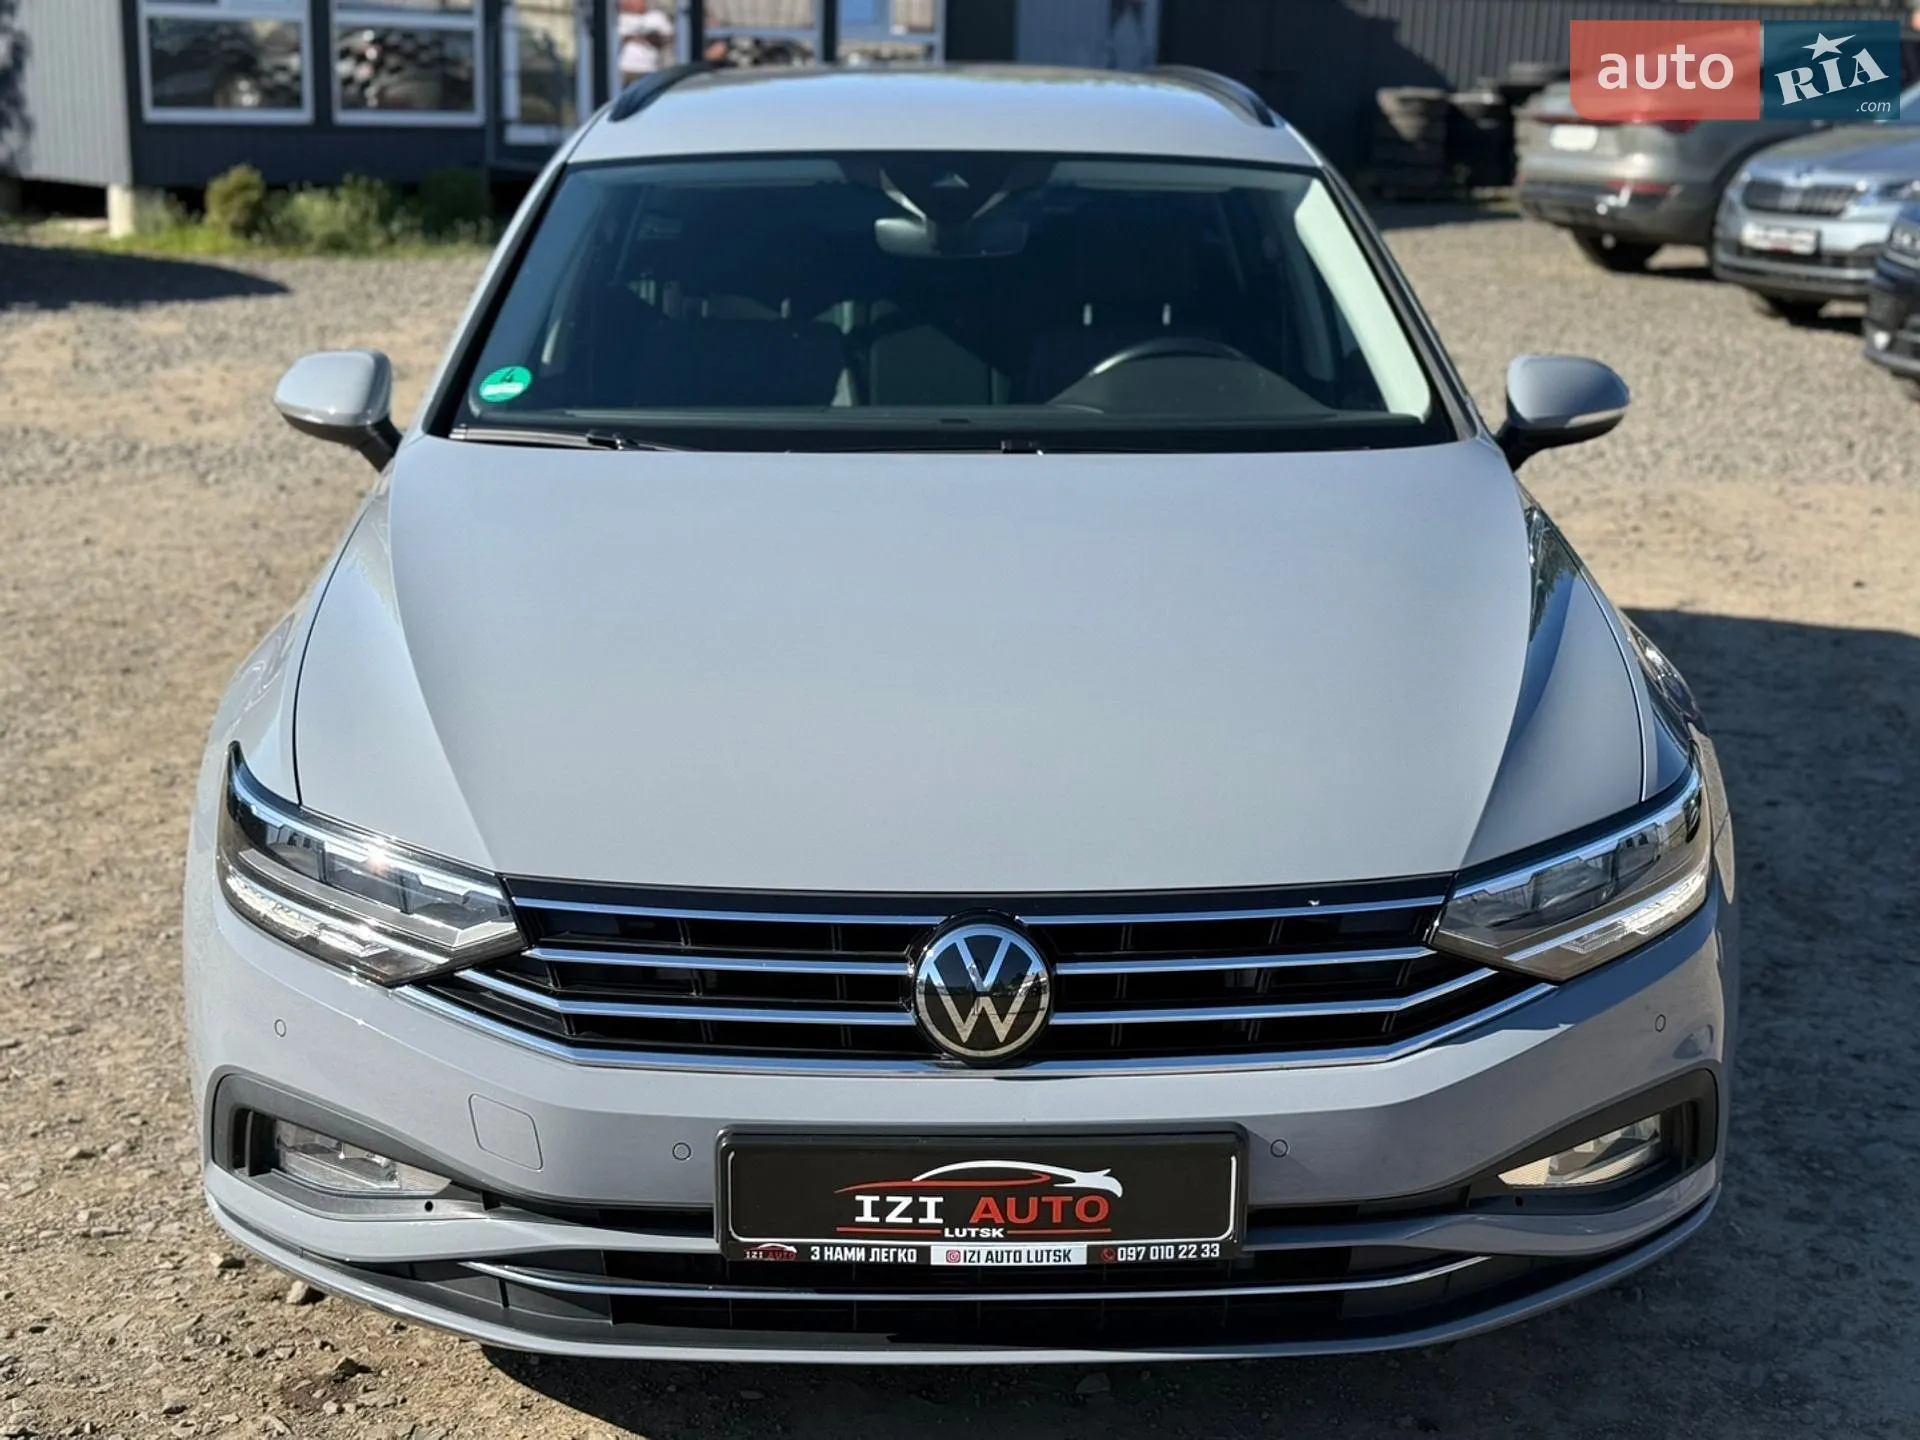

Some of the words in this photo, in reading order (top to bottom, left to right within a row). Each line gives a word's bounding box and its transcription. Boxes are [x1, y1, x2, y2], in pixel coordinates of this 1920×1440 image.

[855, 1194, 944, 1224] IZI
[969, 1196, 1110, 1224] AUTO
[943, 1227, 1005, 1239] LUTSK
[824, 1246, 866, 1262] НАМИ
[868, 1247, 918, 1263] ЛЕГКО
[963, 1250, 981, 1264] IZI
[985, 1249, 1022, 1264] AUTO
[1026, 1249, 1072, 1264] LUTSK
[1117, 1246, 1146, 1262] 097
[1149, 1245, 1175, 1260] 010
[1178, 1244, 1198, 1259] 22
[1201, 1243, 1220, 1258] 33
